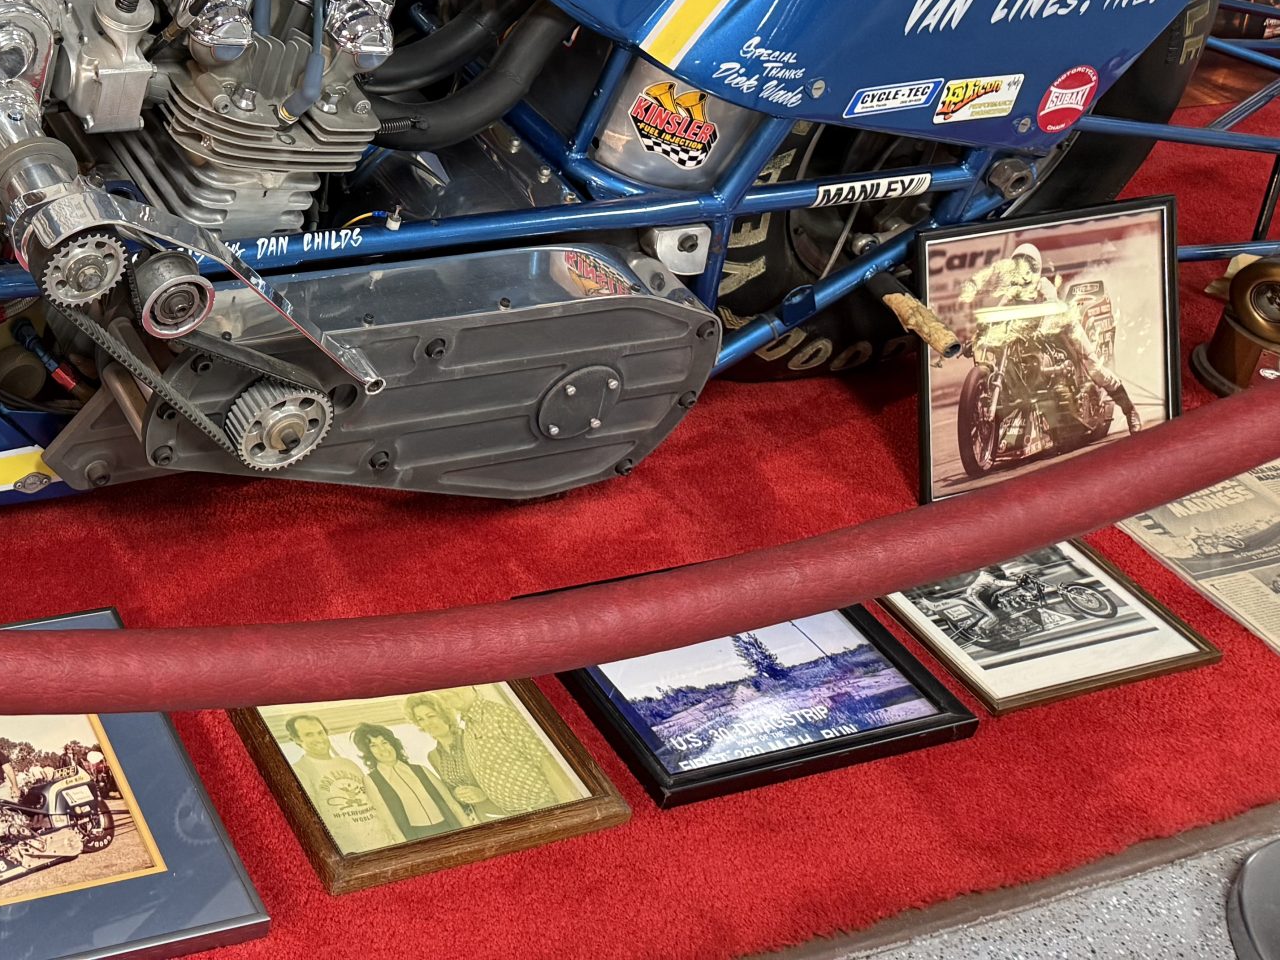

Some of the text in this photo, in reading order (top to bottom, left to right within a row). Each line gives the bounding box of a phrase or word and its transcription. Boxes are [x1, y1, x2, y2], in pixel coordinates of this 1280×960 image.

[739, 37, 797, 64] SPECIAL
[712, 62, 803, 108] Dick Wade
[762, 62, 806, 80] THANKS
[1054, 66, 1097, 86] MOTORCYCLE
[632, 96, 715, 144] KINSLER
[639, 122, 704, 149] FUEL INJECTION
[816, 175, 915, 208] MANLEY
[256, 235, 288, 260] DAN
[303, 228, 363, 252] CHILDS
[1168, 485, 1255, 519] MADNESS
[670, 734, 708, 752] U.S.
[733, 706, 828, 738] DRAGSTRIP
